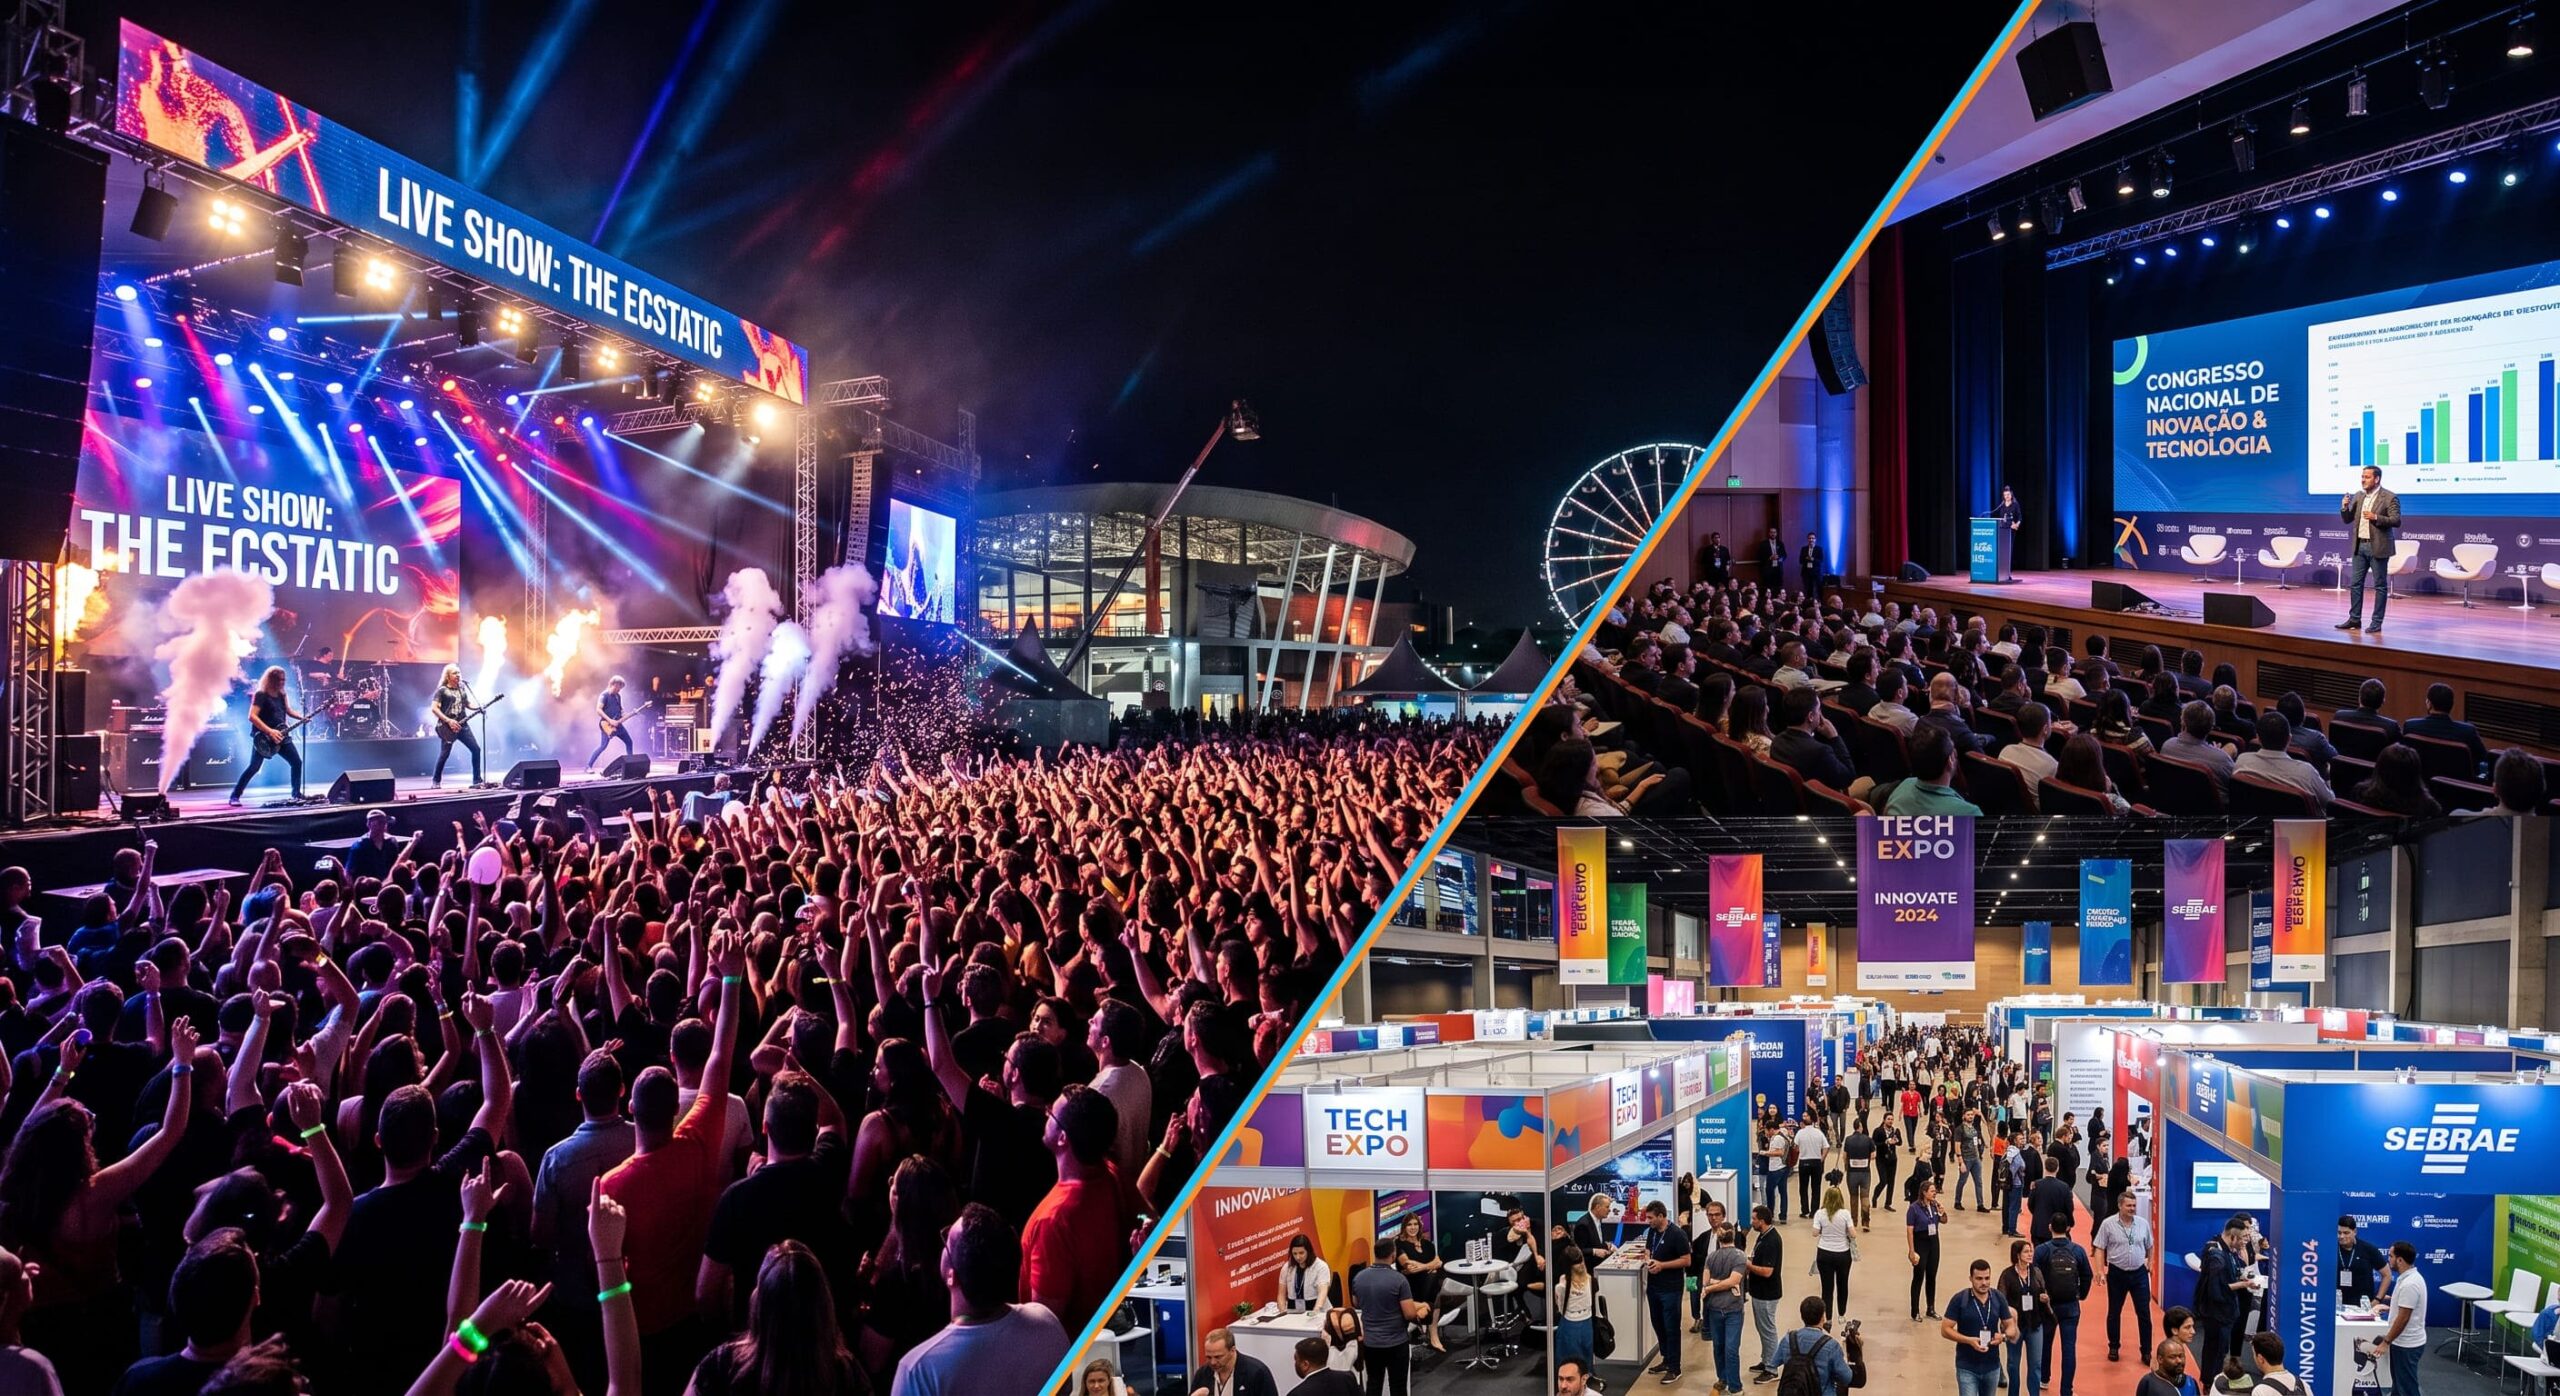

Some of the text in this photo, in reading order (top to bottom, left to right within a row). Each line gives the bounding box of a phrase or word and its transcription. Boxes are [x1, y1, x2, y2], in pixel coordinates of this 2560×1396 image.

[379, 167, 723, 360] LIVE SHOW: THE ECSTATIC
[2146, 360, 2264, 391] CONGRESSO
[2146, 384, 2279, 414] NACIONAL DE
[2146, 407, 2268, 437] INOVAÇÃO &
[2146, 435, 2271, 459] TECNOLOGIA
[167, 475, 333, 531] LIVE SHOW:
[81, 509, 399, 595] THE ECSTATIC
[1878, 816, 1954, 836] TECH
[1878, 839, 1955, 859] EXPO
[1874, 892, 1958, 905] INNOVATE
[1895, 909, 1939, 922] 2024
[1616, 1083, 1637, 1105] TECH
[1324, 1108, 1407, 1132] TECH
[1616, 1103, 1638, 1126] EXPO
[1326, 1134, 1408, 1156] EXPO
[2384, 1127, 2520, 1154] SEBRAE
[2299, 1292, 2317, 1384] INNOVATE
